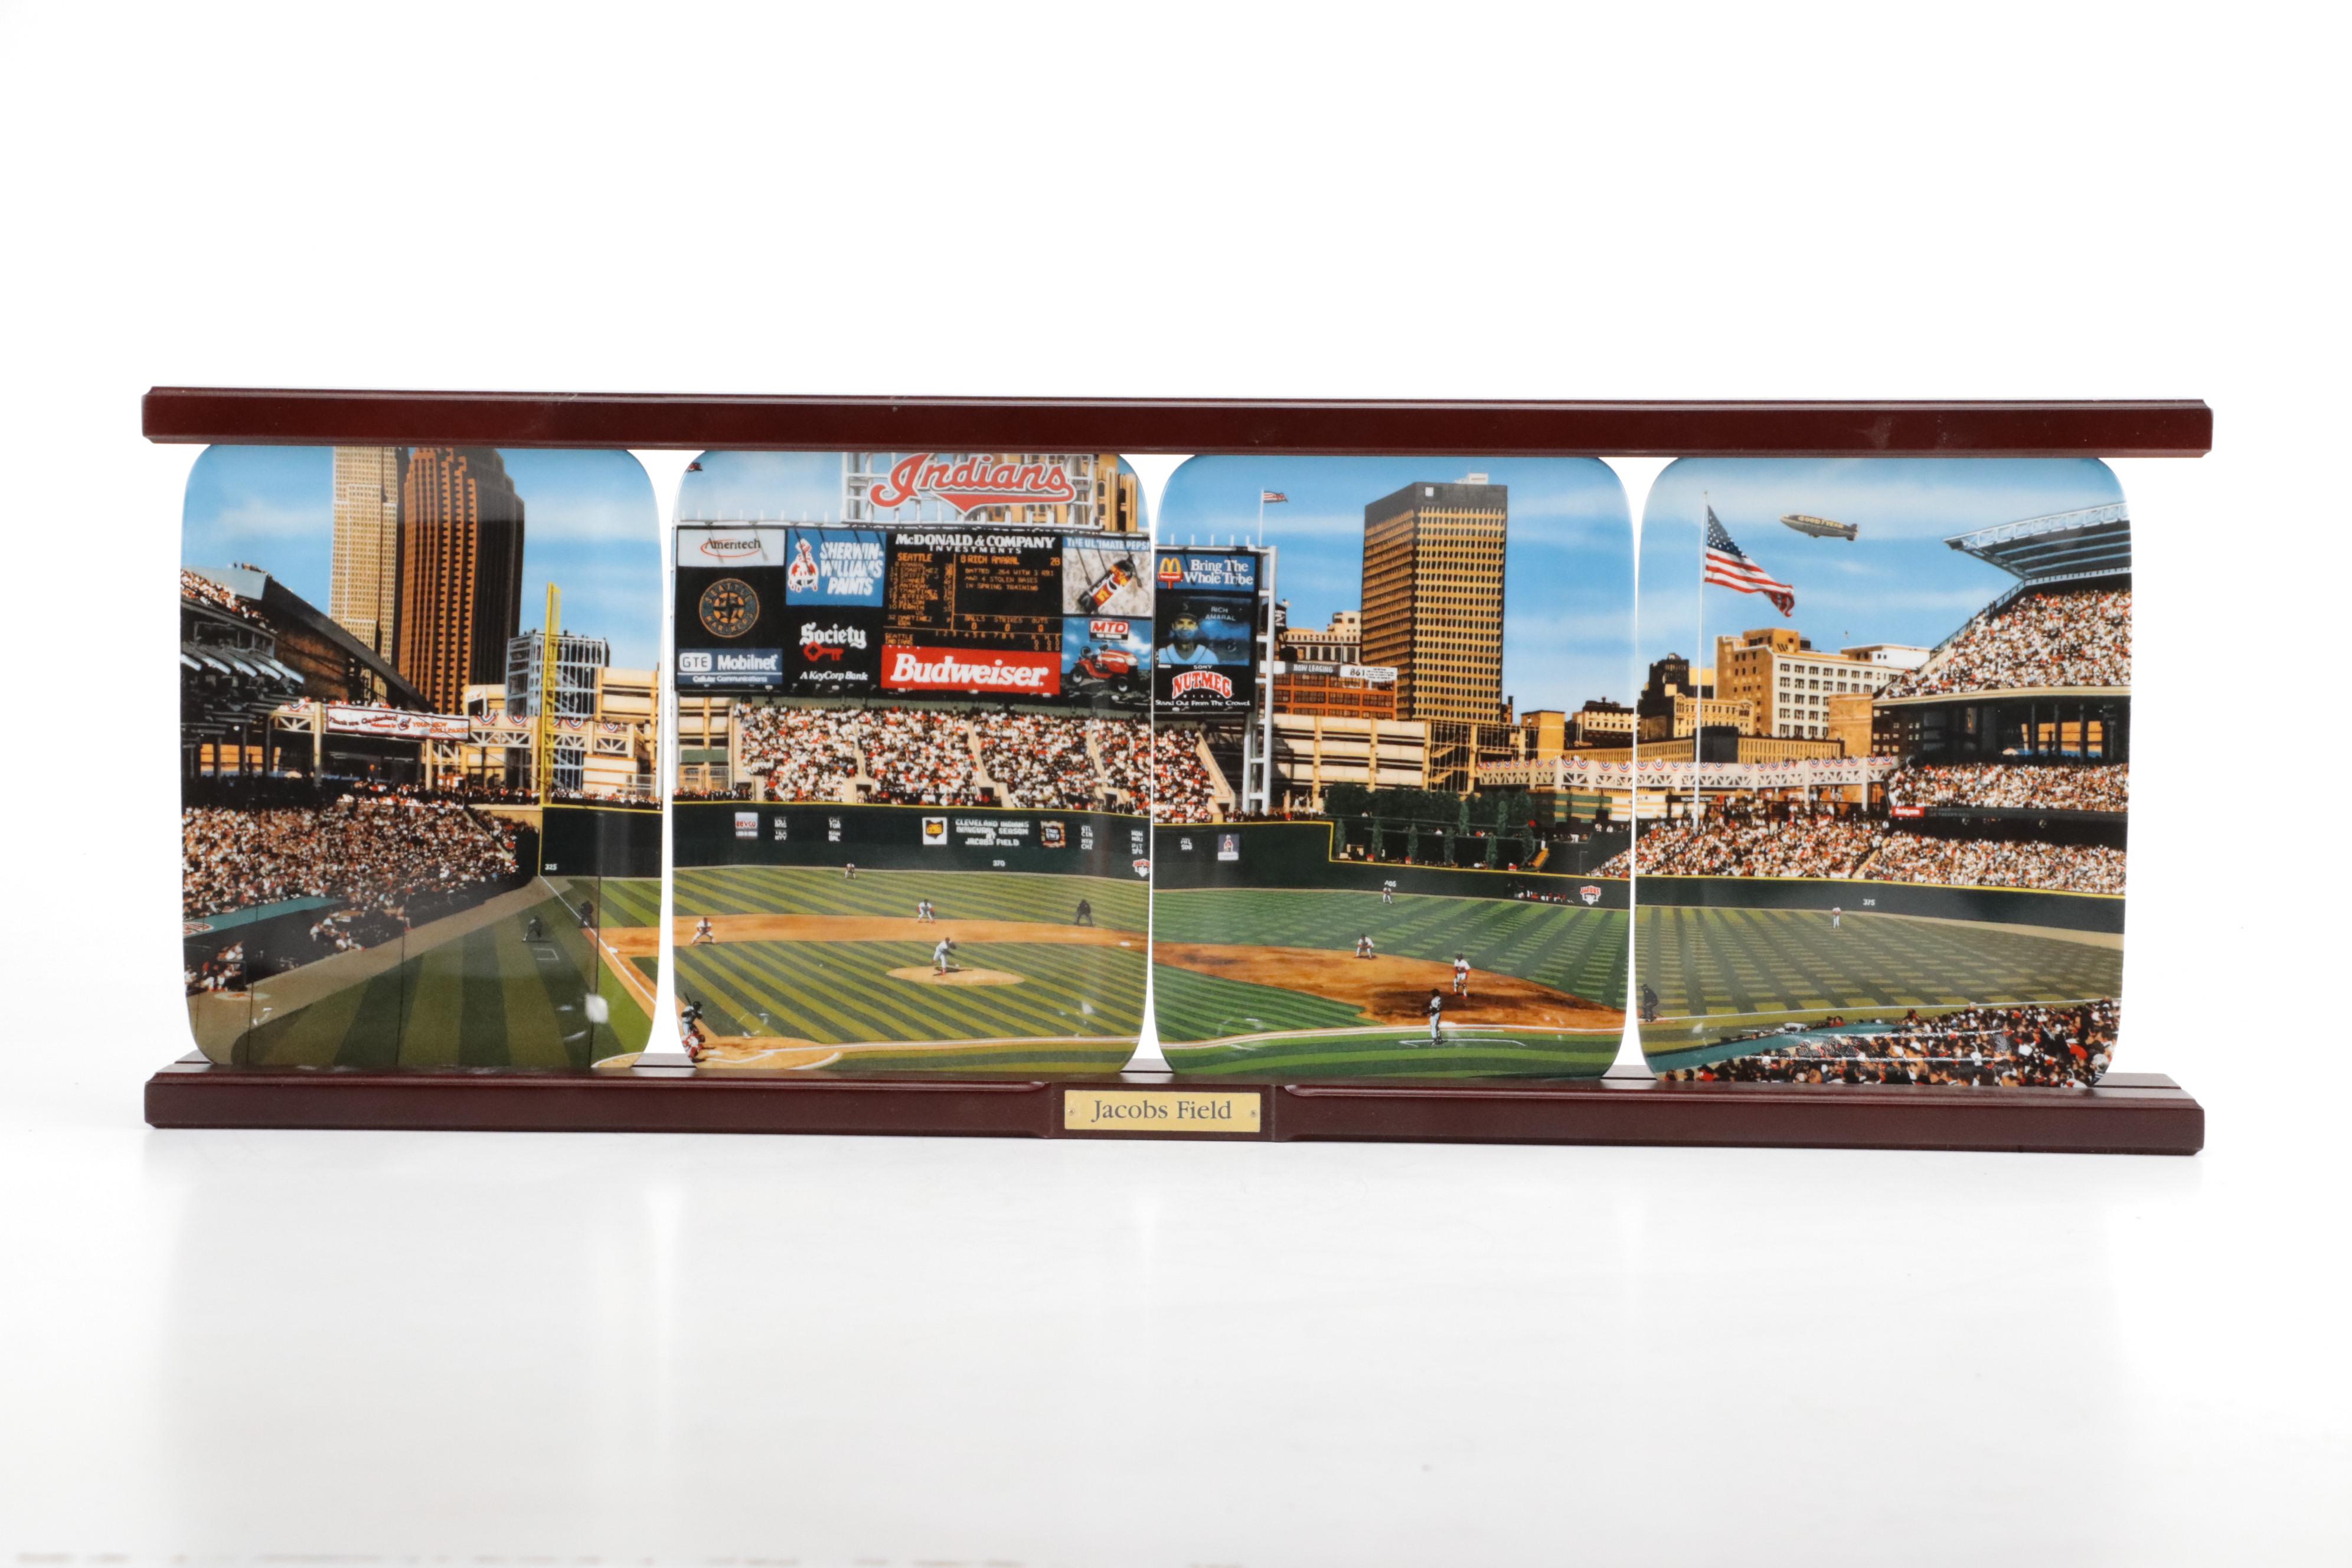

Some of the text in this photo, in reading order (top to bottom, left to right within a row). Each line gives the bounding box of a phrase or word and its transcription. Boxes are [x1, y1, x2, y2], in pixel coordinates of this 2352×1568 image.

[868, 453, 1077, 515] Indians
[704, 537, 761, 550] Ameritech
[895, 534, 1056, 549] McDONALD & COMPANY
[1066, 538, 1083, 548] THE
[819, 541, 884, 560] SHERWIN-
[929, 545, 1022, 554] INVESTMENTS
[897, 552, 932, 563] SEATTLE
[968, 554, 988, 564] RICH
[991, 556, 1020, 566] AMARAL
[1190, 558, 1249, 574] Bring The
[1182, 571, 1254, 584] Whole Tribe
[704, 582, 753, 603] SEATTLE
[827, 577, 874, 596] PAINTS
[1007, 583, 1039, 592] TRAINING
[994, 615, 1023, 624] STRIKES
[1092, 622, 1127, 633] MTD
[799, 622, 867, 649] Society
[682, 654, 778, 671] GTE Mobilnet
[890, 652, 1050, 687] Budweiser
[1293, 664, 1334, 674] NOW LEASING
[799, 670, 868, 681] A KeyCorp Bank
[1171, 670, 1233, 700] NUTMEG
[955, 818, 1030, 828] CLEVELAND INDIANS
[998, 827, 1029, 835] SEASON
[995, 838, 1020, 847] FIELD
[1863, 898, 1876, 906] 375
[1090, 1100, 1233, 1123] Jacobs Field
